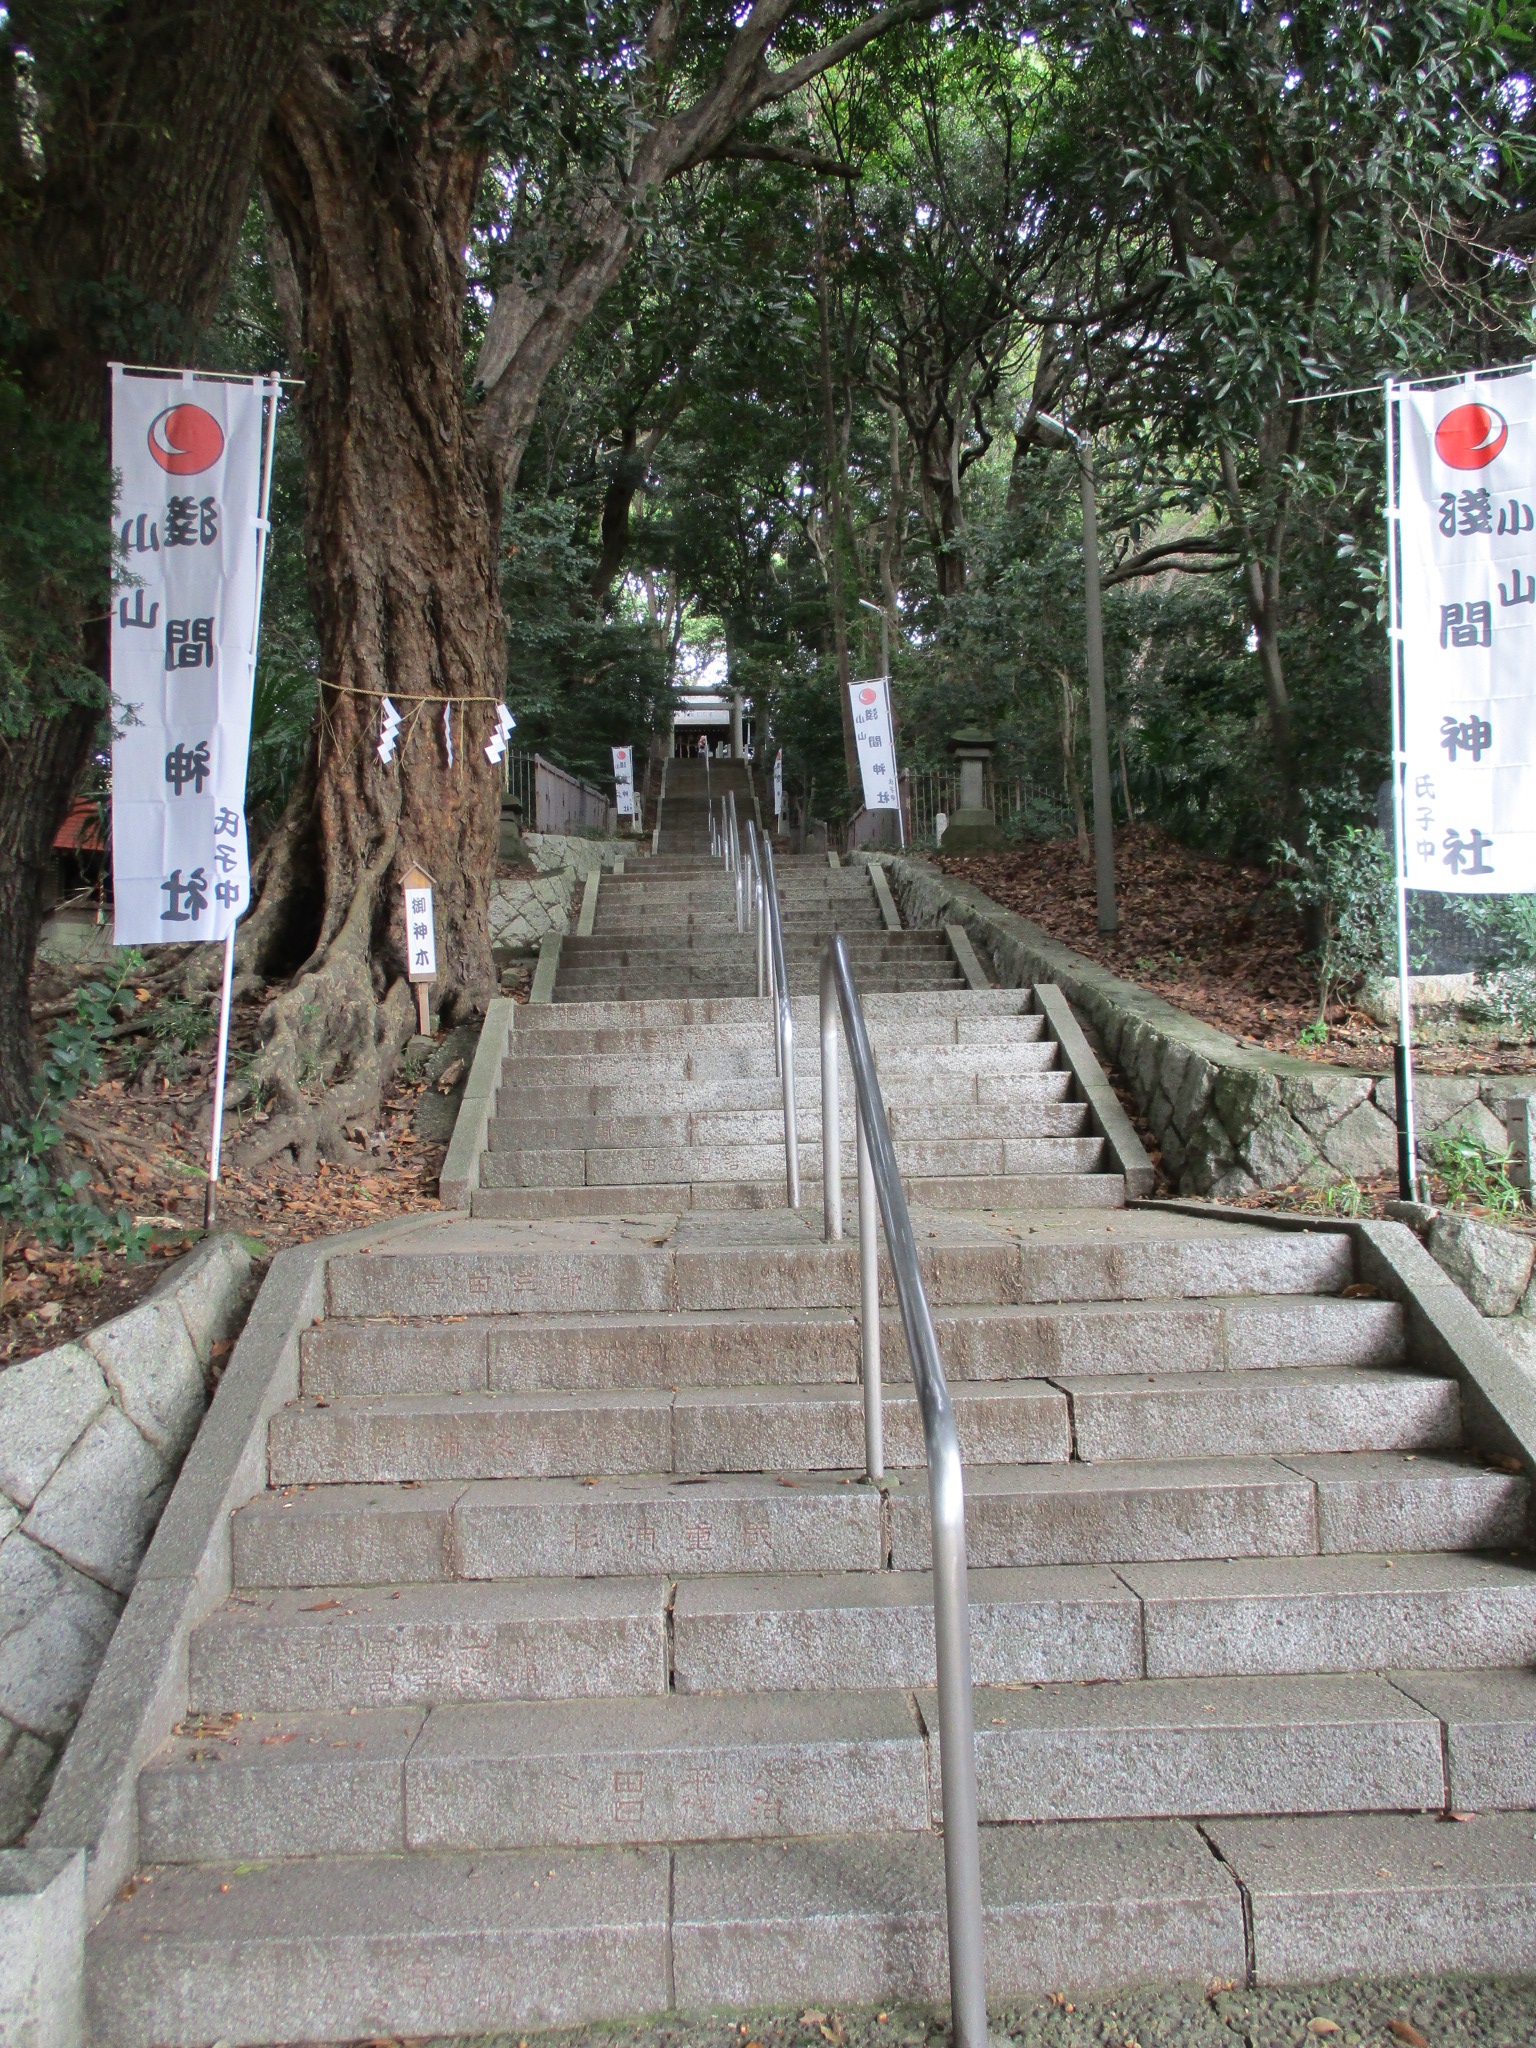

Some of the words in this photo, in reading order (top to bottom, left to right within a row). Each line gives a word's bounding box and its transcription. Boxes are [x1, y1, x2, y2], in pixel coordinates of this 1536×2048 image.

[1496, 498, 1535, 608] 小山
[1413, 773, 1436, 864] 氏子中
[411, 897, 431, 966] 御神木
